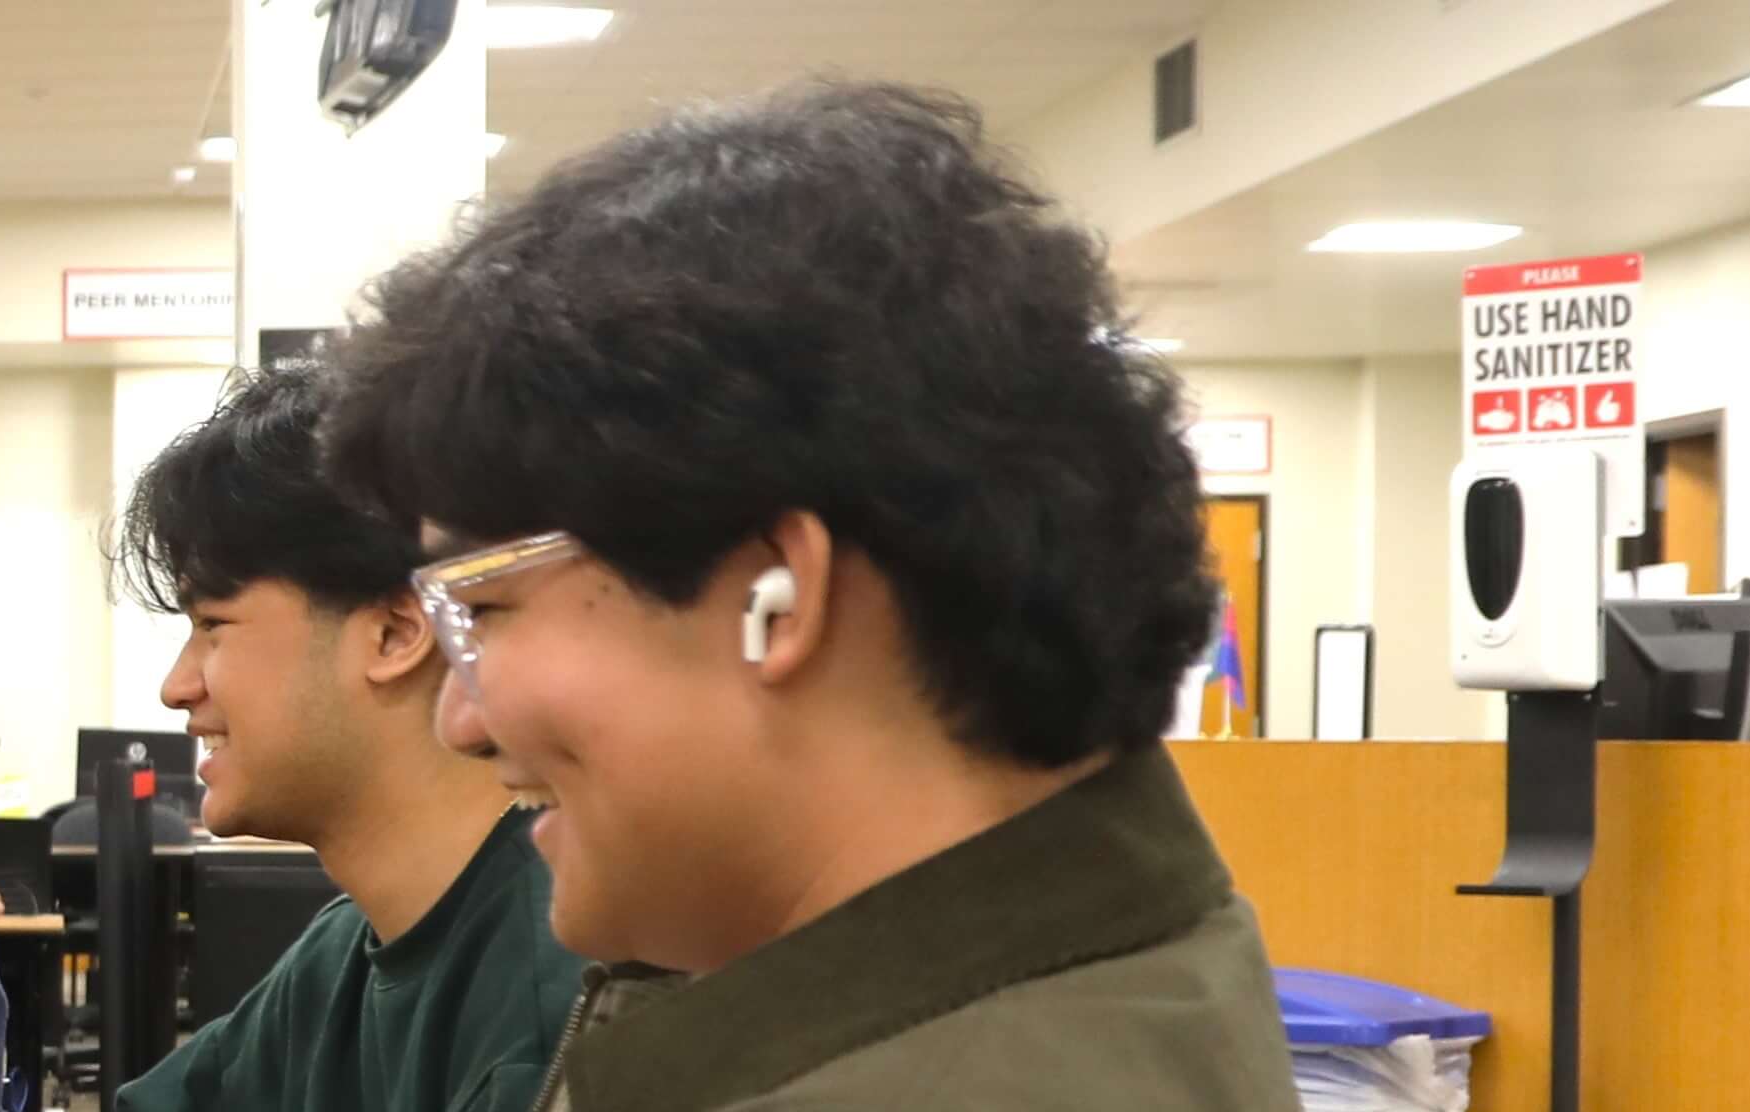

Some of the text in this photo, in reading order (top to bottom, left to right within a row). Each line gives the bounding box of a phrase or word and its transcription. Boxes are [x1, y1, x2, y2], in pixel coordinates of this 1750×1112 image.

[1523, 266, 1580, 284] PLEASE
[74, 293, 126, 308] PEER
[1475, 295, 1632, 338] USE HAND
[1476, 339, 1632, 381] SANITIZER
